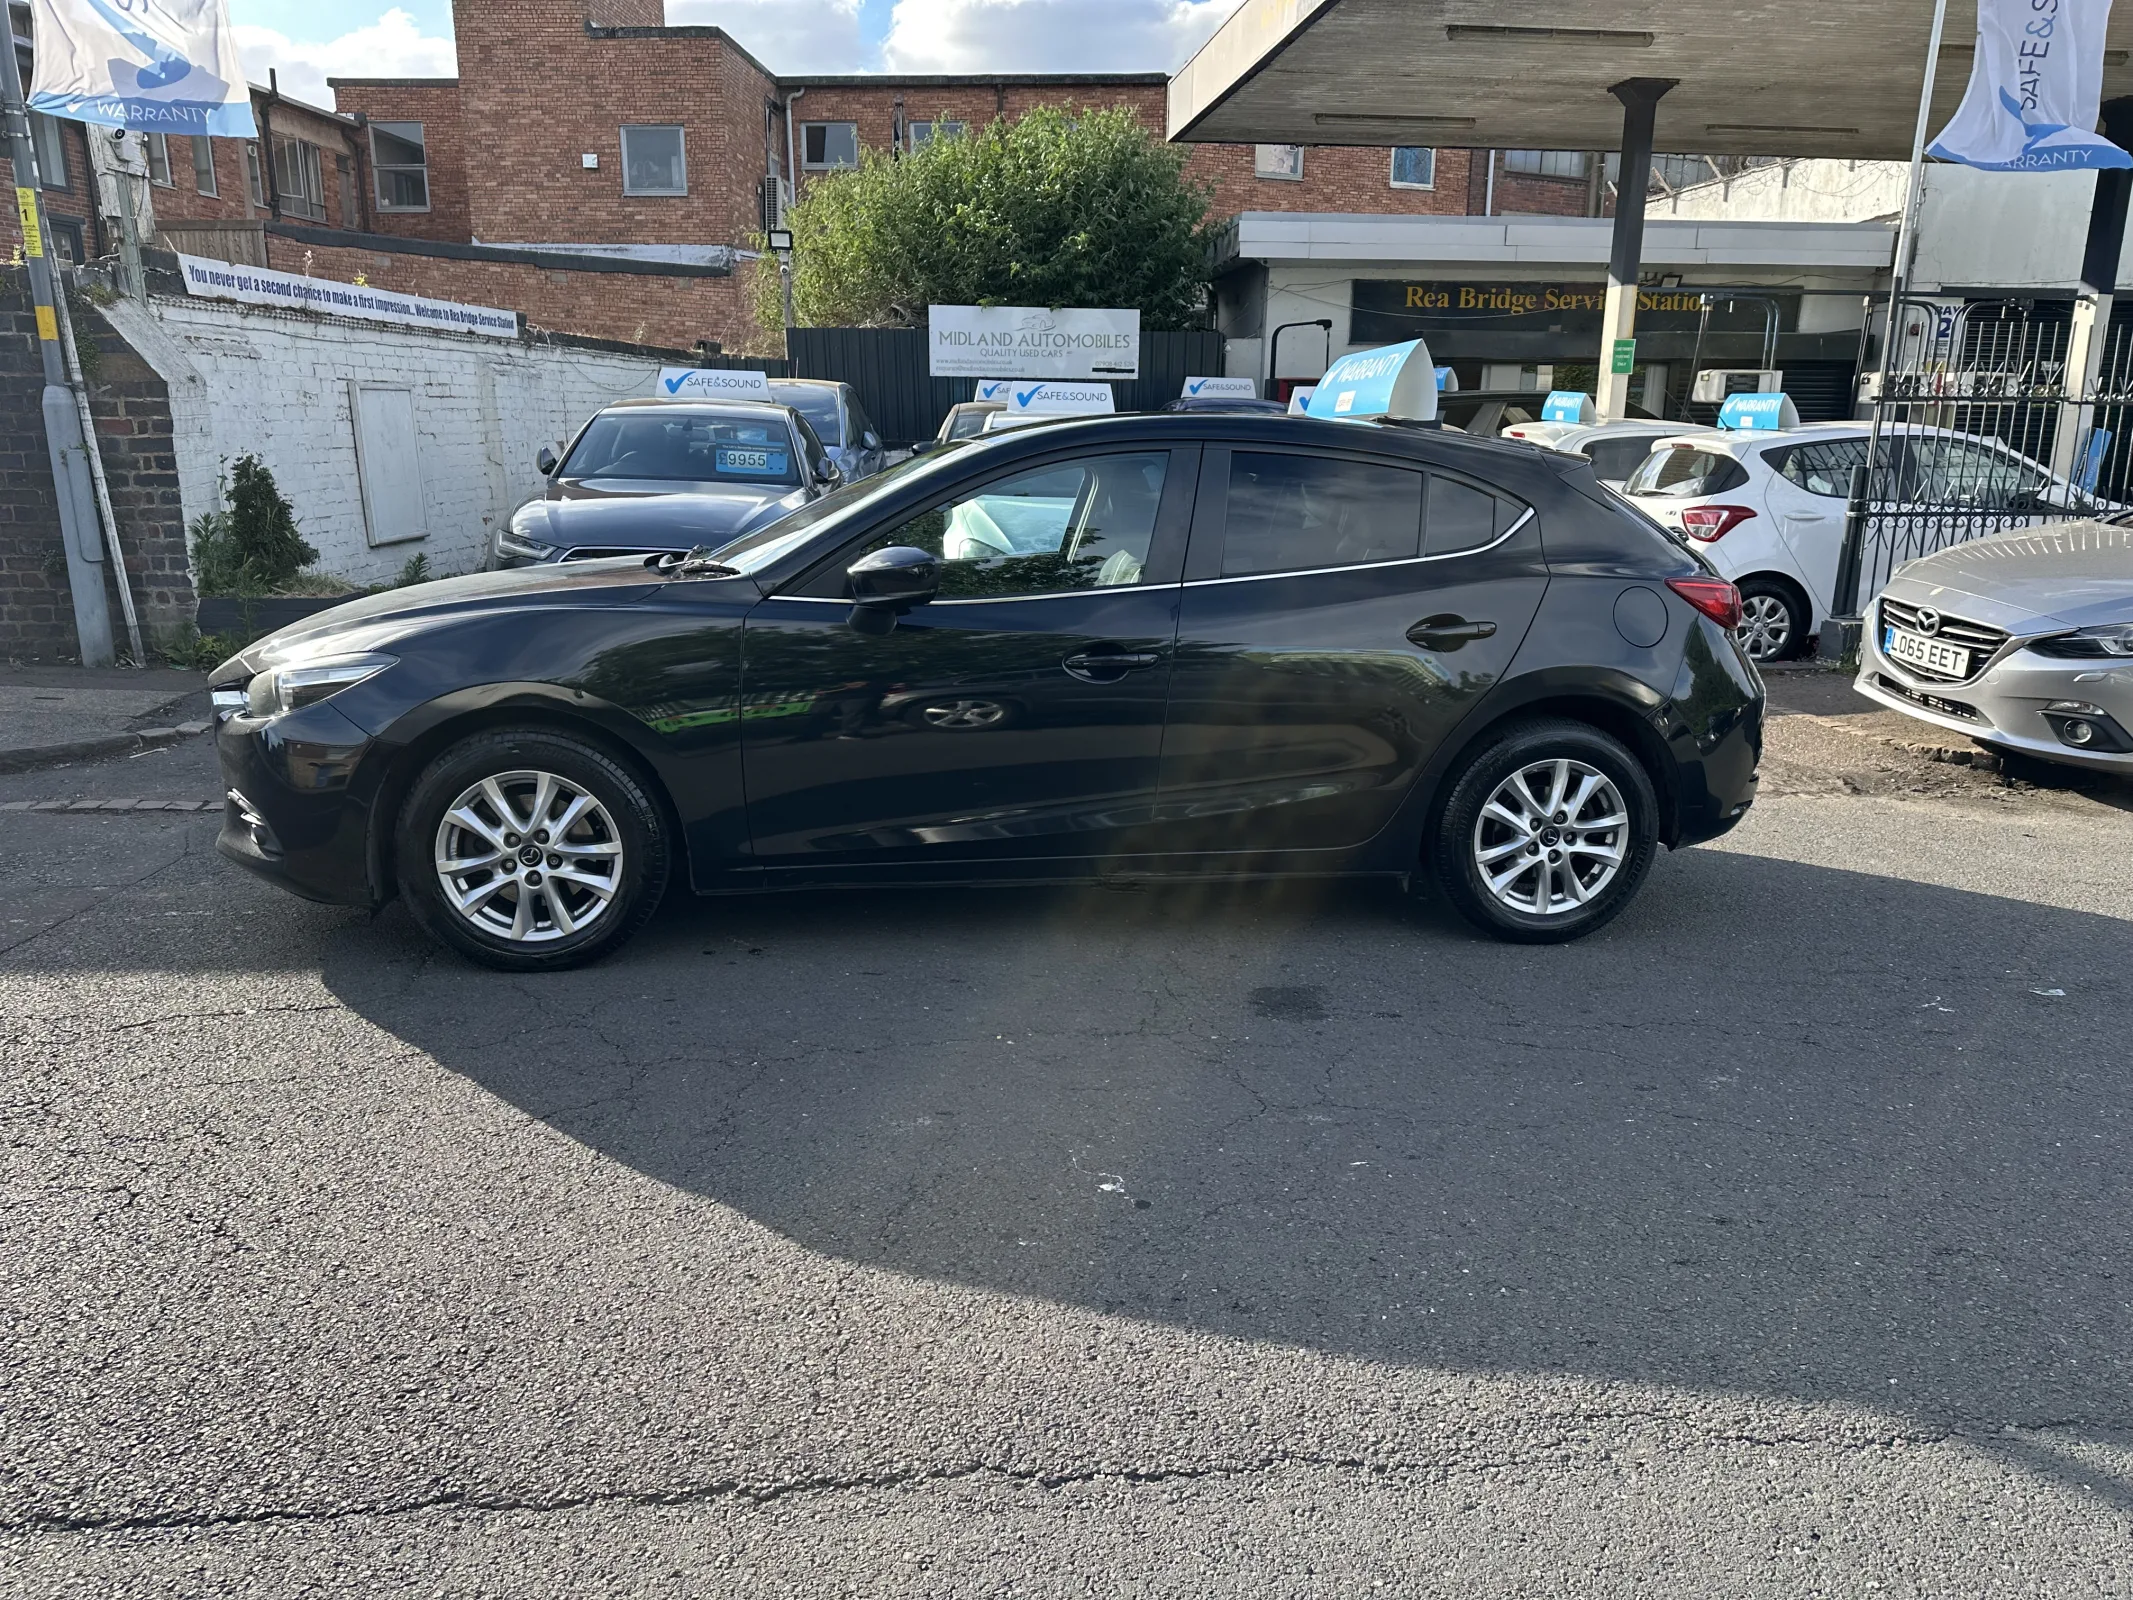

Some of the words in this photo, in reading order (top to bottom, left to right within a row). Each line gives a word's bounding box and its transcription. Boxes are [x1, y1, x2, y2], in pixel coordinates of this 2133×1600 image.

[96, 100, 211, 124] WARRANTY
[2000, 149, 2093, 170] ARRANTY
[188, 264, 208, 284] You
[209, 271, 236, 288] never
[237, 276, 253, 292] get
[253, 278, 260, 292] a
[261, 279, 292, 297] second
[293, 284, 322, 301] chance
[322, 288, 331, 303] to
[332, 290, 352, 306] make
[353, 295, 358, 307] a
[359, 294, 375, 310] first
[414, 303, 443, 320] Welcome
[443, 308, 450, 321] to
[460, 310, 478, 326] Bridge
[479, 313, 497, 328] Service
[497, 315, 514, 330] Station
[1405, 286, 1449, 308] Rea
[1458, 287, 1538, 315] Bridge
[1544, 289, 1606, 310] Servi
[1938, 317, 1953, 338] 2
[938, 330, 1013, 346] MIDLAND
[1018, 333, 1130, 349] AUTOMOBILES
[980, 349, 1017, 358] QUALITY
[1019, 349, 1040, 358] USED
[1041, 350, 1063, 358] CARS
[1337, 352, 1406, 382] WARRANTY
[687, 377, 761, 389] SAFE&SOUND
[1037, 390, 1107, 402] SAFE&SOUND
[1736, 399, 1779, 413] WARRANTY
[1928, 644, 1962, 670] EET
